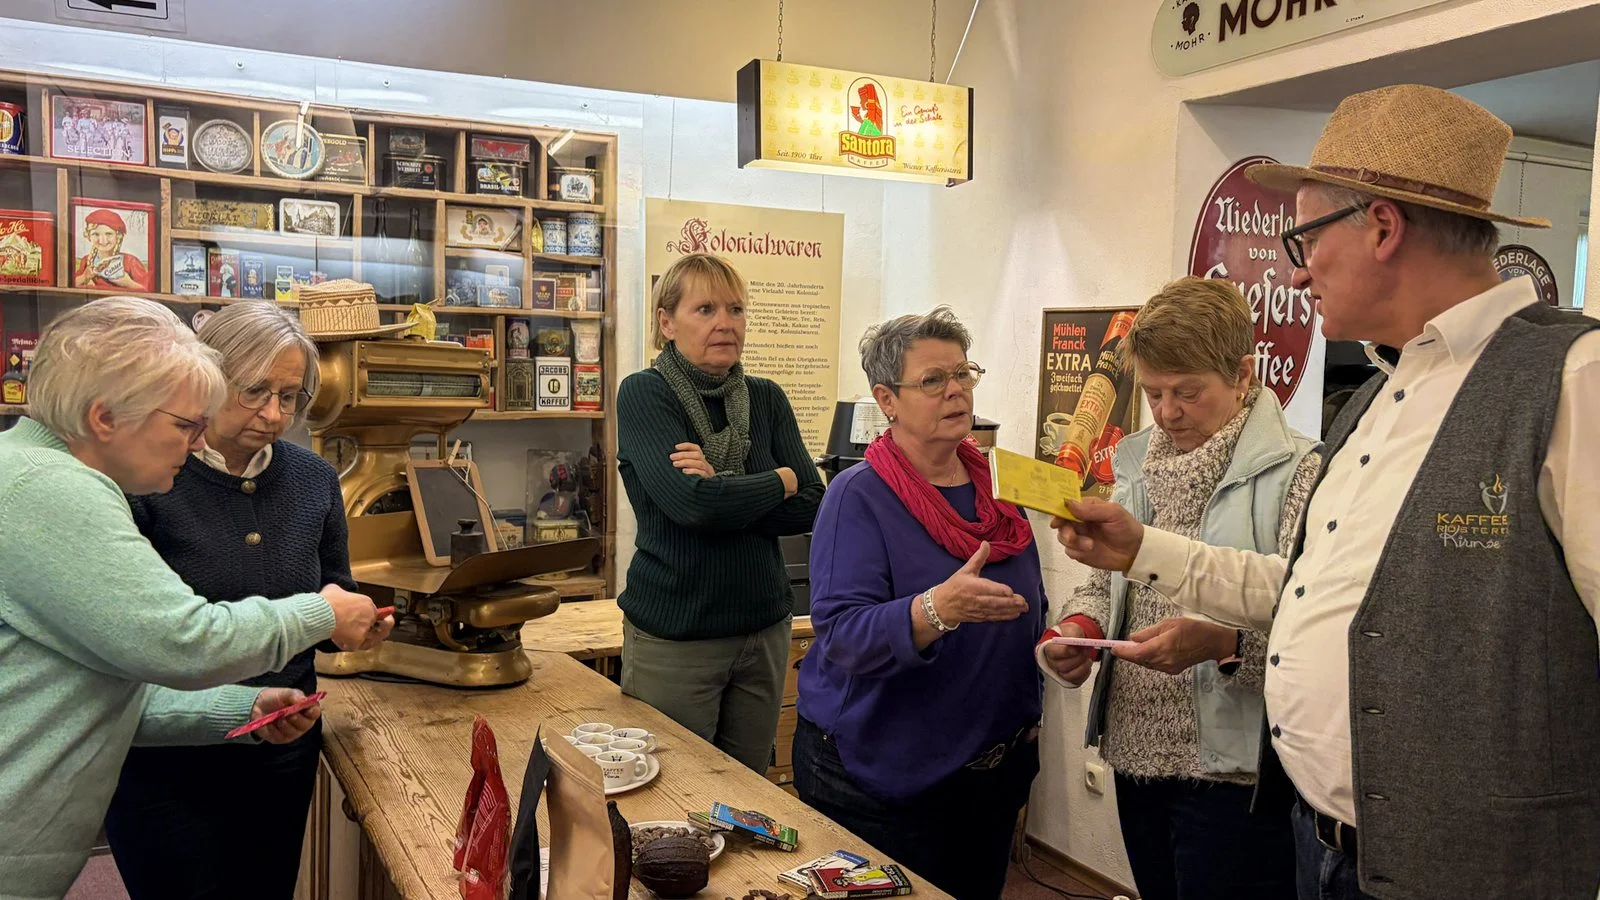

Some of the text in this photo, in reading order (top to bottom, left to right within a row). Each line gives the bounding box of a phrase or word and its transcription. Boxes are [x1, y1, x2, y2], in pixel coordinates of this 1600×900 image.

[841, 133, 895, 156] Santora
[776, 149, 789, 157] Seit
[791, 151, 807, 159] 1900
[1248, 247, 1277, 260] von
[1053, 323, 1086, 337] Mühlen
[1052, 336, 1086, 350] Franck
[1046, 352, 1092, 372] EXTRA
[1437, 512, 1508, 526] KAFFEE
